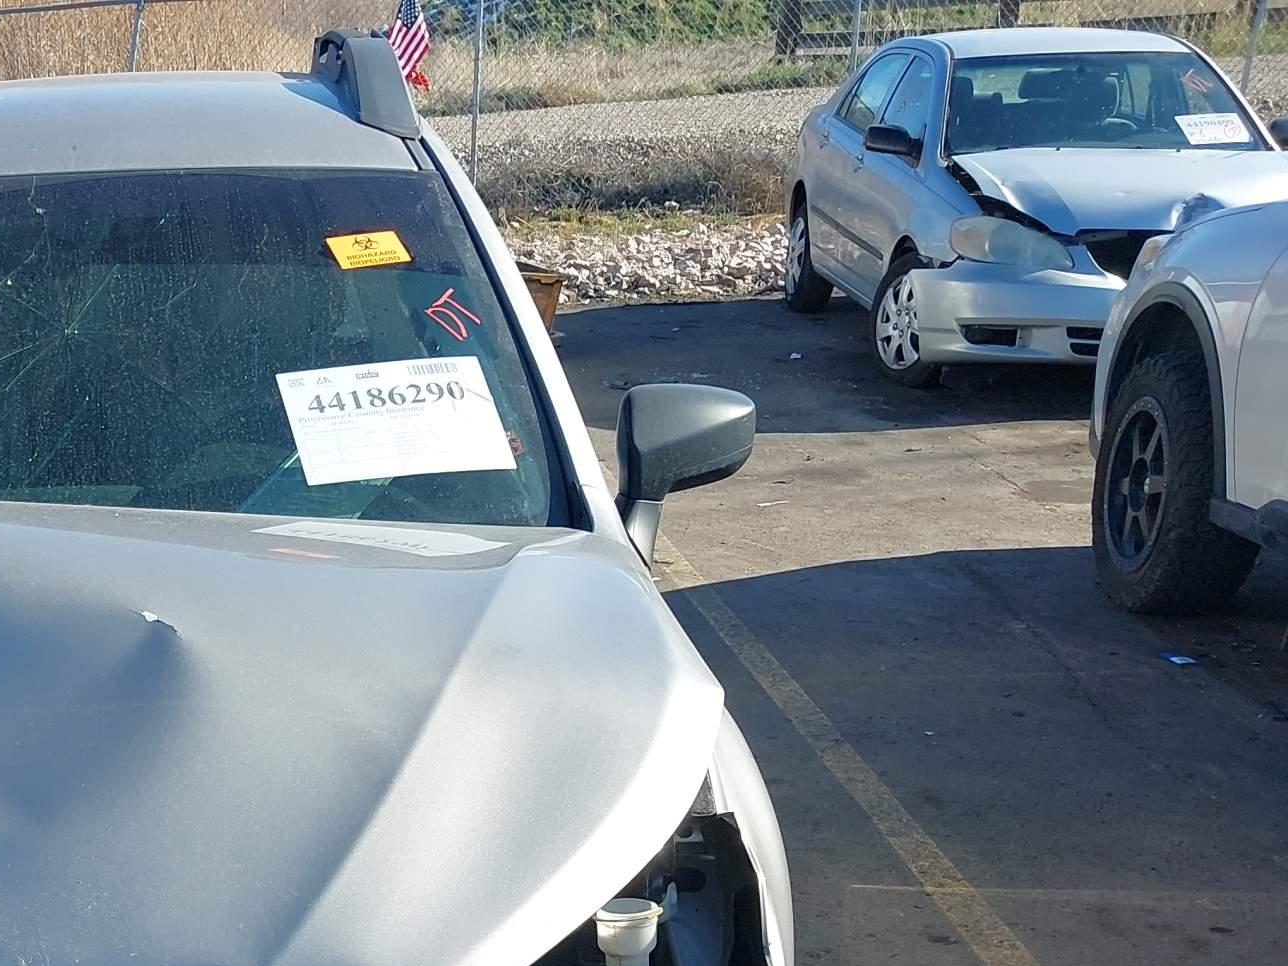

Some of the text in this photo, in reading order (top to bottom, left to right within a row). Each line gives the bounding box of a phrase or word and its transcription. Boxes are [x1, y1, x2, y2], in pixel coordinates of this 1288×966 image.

[346, 250, 397, 261] BIOHAZARD
[349, 255, 401, 266] BIOPELIGRO
[308, 380, 465, 414] 44186290
